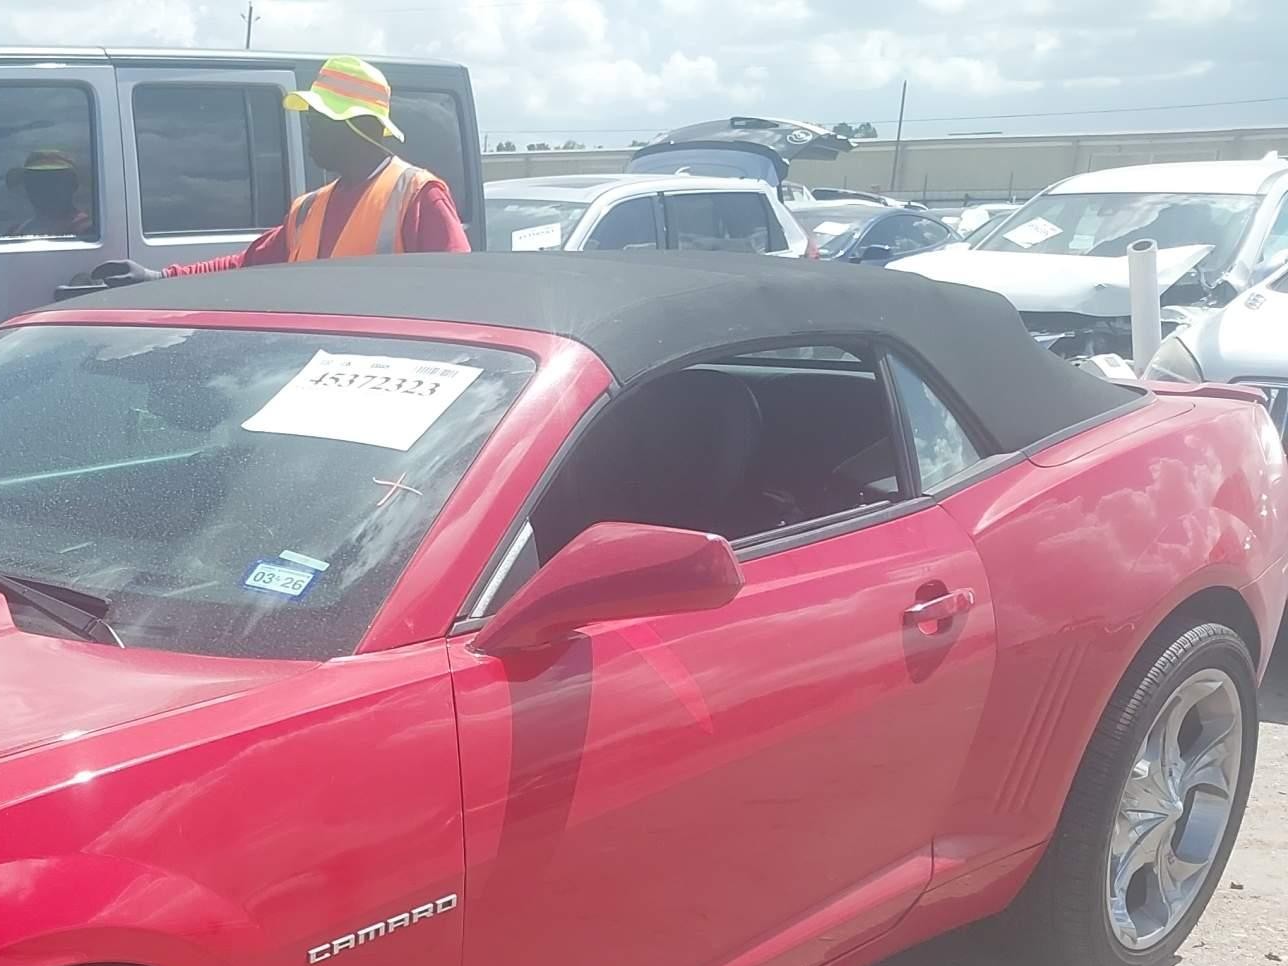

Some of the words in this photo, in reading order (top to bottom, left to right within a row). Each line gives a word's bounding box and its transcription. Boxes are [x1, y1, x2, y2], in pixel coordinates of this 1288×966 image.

[309, 371, 441, 396] 45372323
[253, 571, 276, 585] 03
[280, 577, 305, 591] 26
[307, 893, 458, 964] CAMARO
